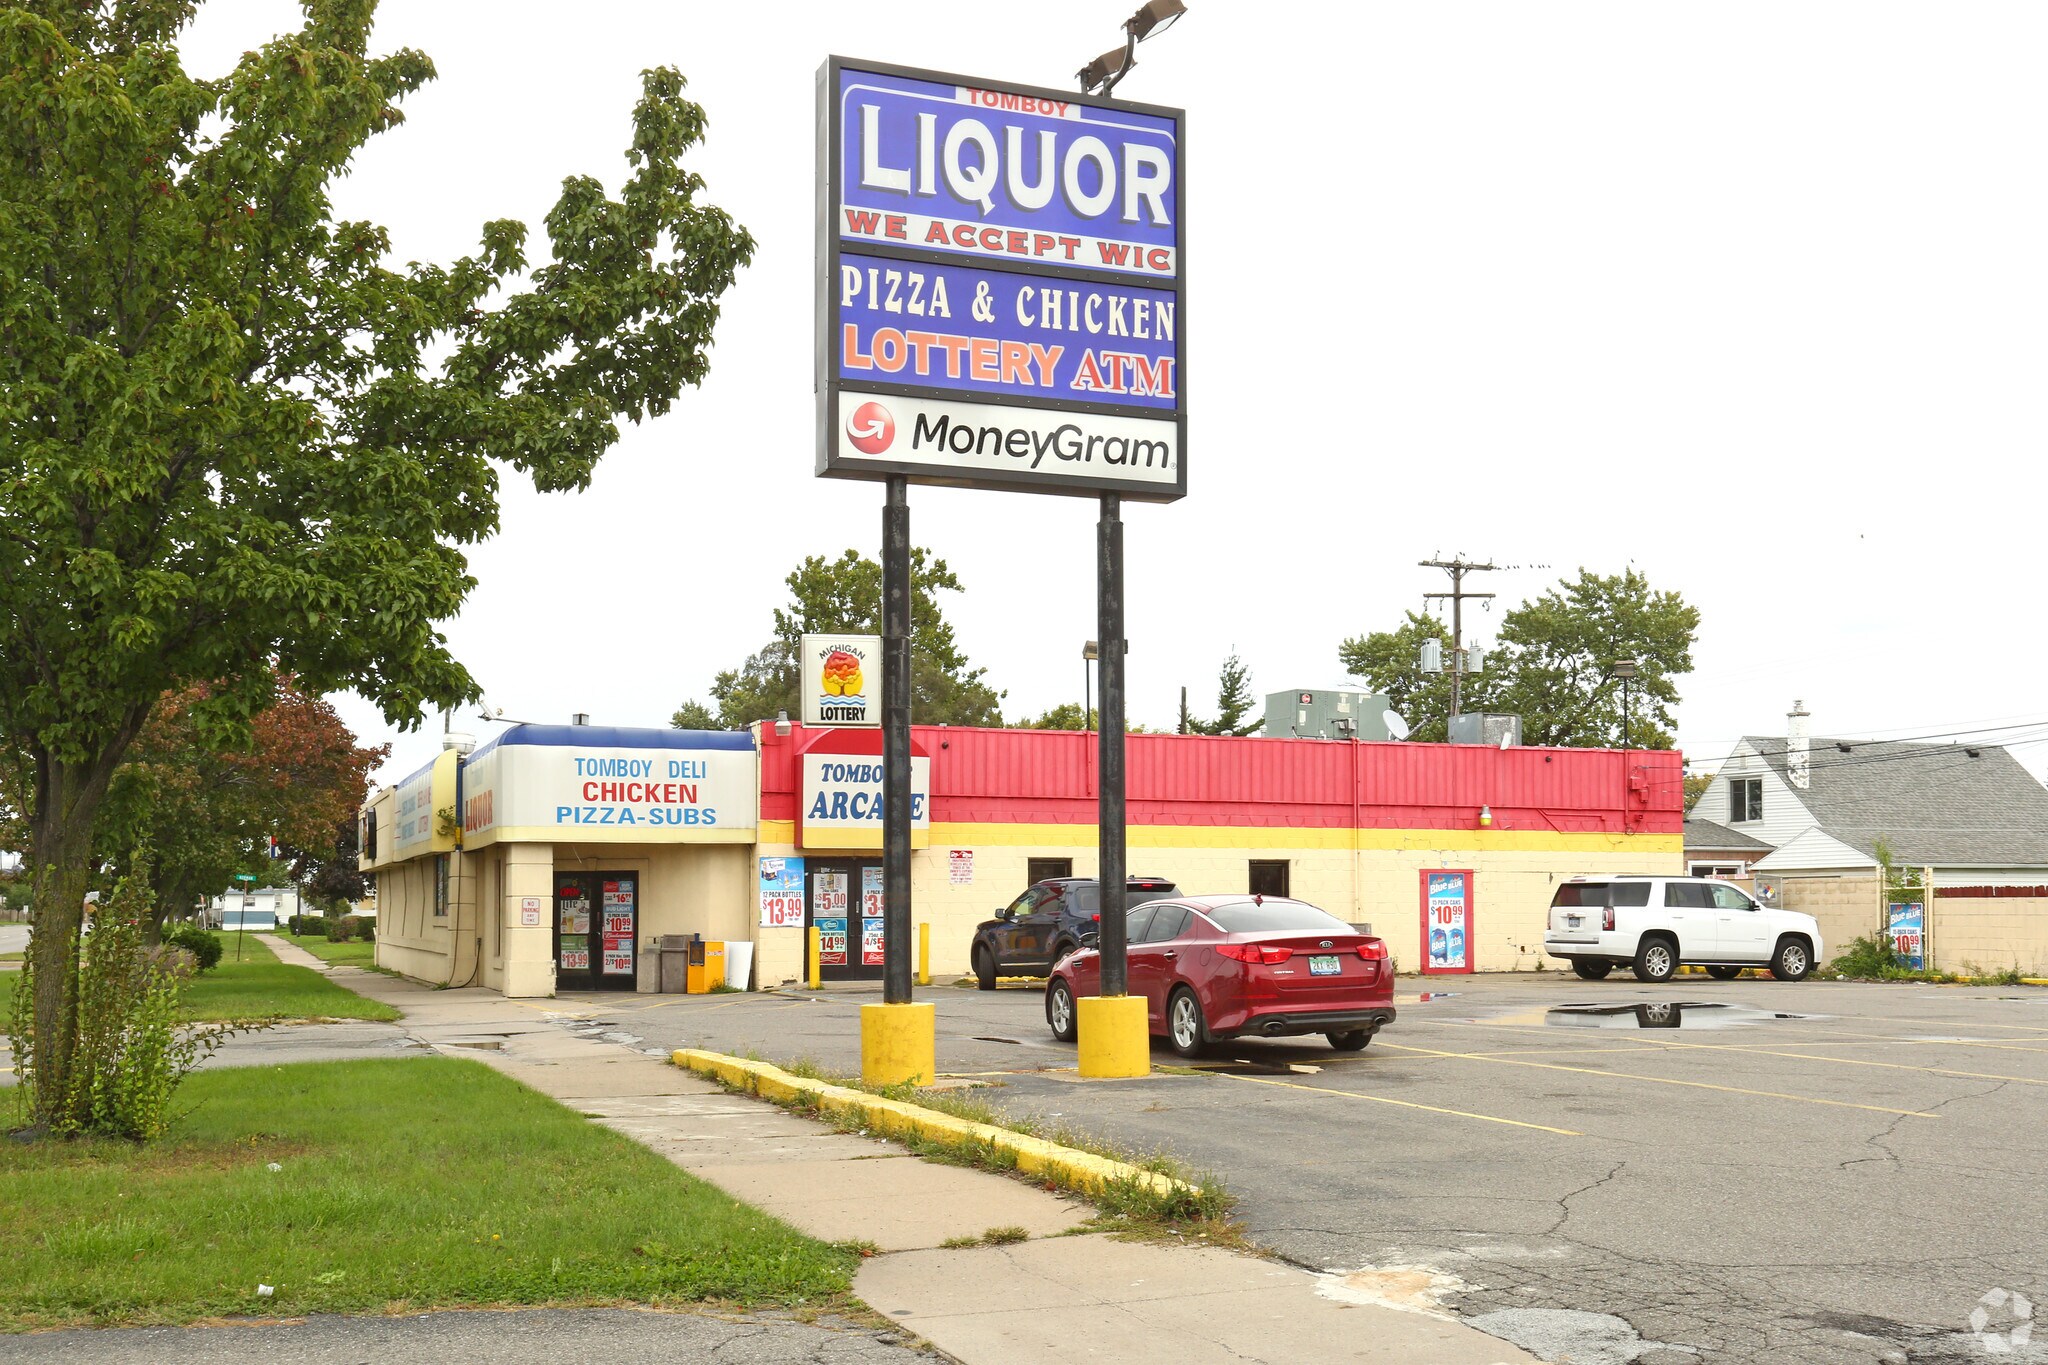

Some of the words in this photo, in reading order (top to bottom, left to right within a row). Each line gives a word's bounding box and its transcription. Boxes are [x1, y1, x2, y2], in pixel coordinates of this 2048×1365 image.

[966, 86, 1071, 118] TOMBOY
[859, 103, 1172, 225] LIQUOR
[844, 208, 908, 239] WE
[925, 221, 1082, 260] ACCEPT
[1097, 241, 1172, 271] WIC
[841, 264, 952, 319] PIZZA
[971, 280, 995, 323] &
[1016, 285, 1175, 342] CHICKEN
[842, 323, 1065, 387] LOTTERY
[1070, 348, 1176, 399] ATM
[911, 412, 1170, 470] MoneyGram
[819, 644, 866, 660] MICHIGAN
[820, 706, 866, 721] LOTTERY
[574, 757, 653, 778] TOMBOY
[668, 760, 706, 779] DELI
[582, 781, 698, 804] CHICKEN
[807, 790, 925, 821] ARCAE
[465, 788, 494, 833] LIQUOR
[556, 806, 717, 825] PIZZA-SUBS
[1430, 882, 1448, 895] Blue
[562, 900, 578, 911] Lite
[762, 898, 802, 925] $13.99
[1431, 940, 1446, 952] Blue
